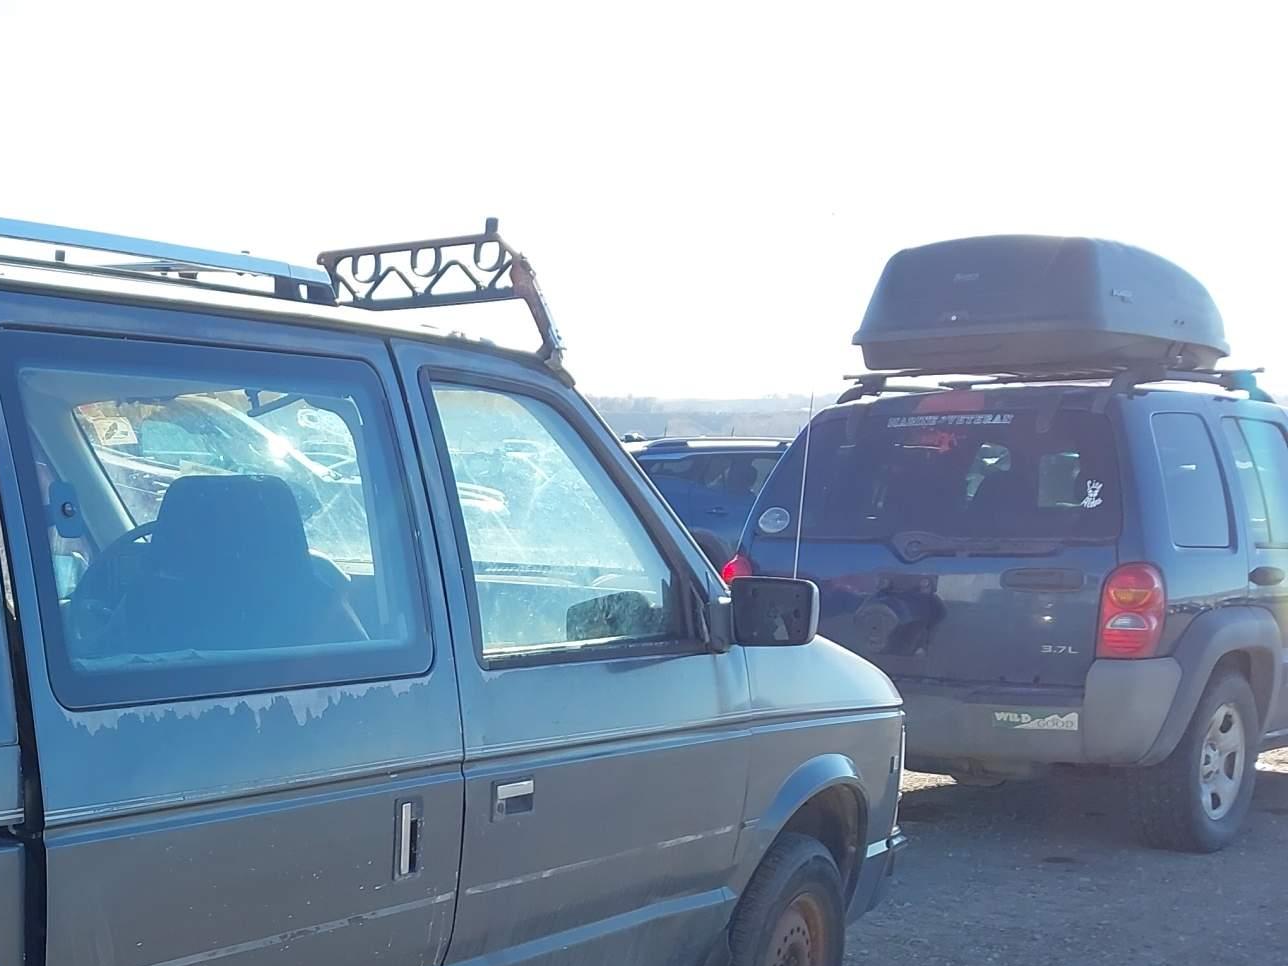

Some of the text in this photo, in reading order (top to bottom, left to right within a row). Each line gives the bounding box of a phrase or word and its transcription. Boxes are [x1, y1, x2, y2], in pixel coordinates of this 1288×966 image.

[945, 413, 1014, 425] VETERAN
[1040, 645, 1079, 654] 3.7L
[1036, 719, 1074, 729] GOOD
